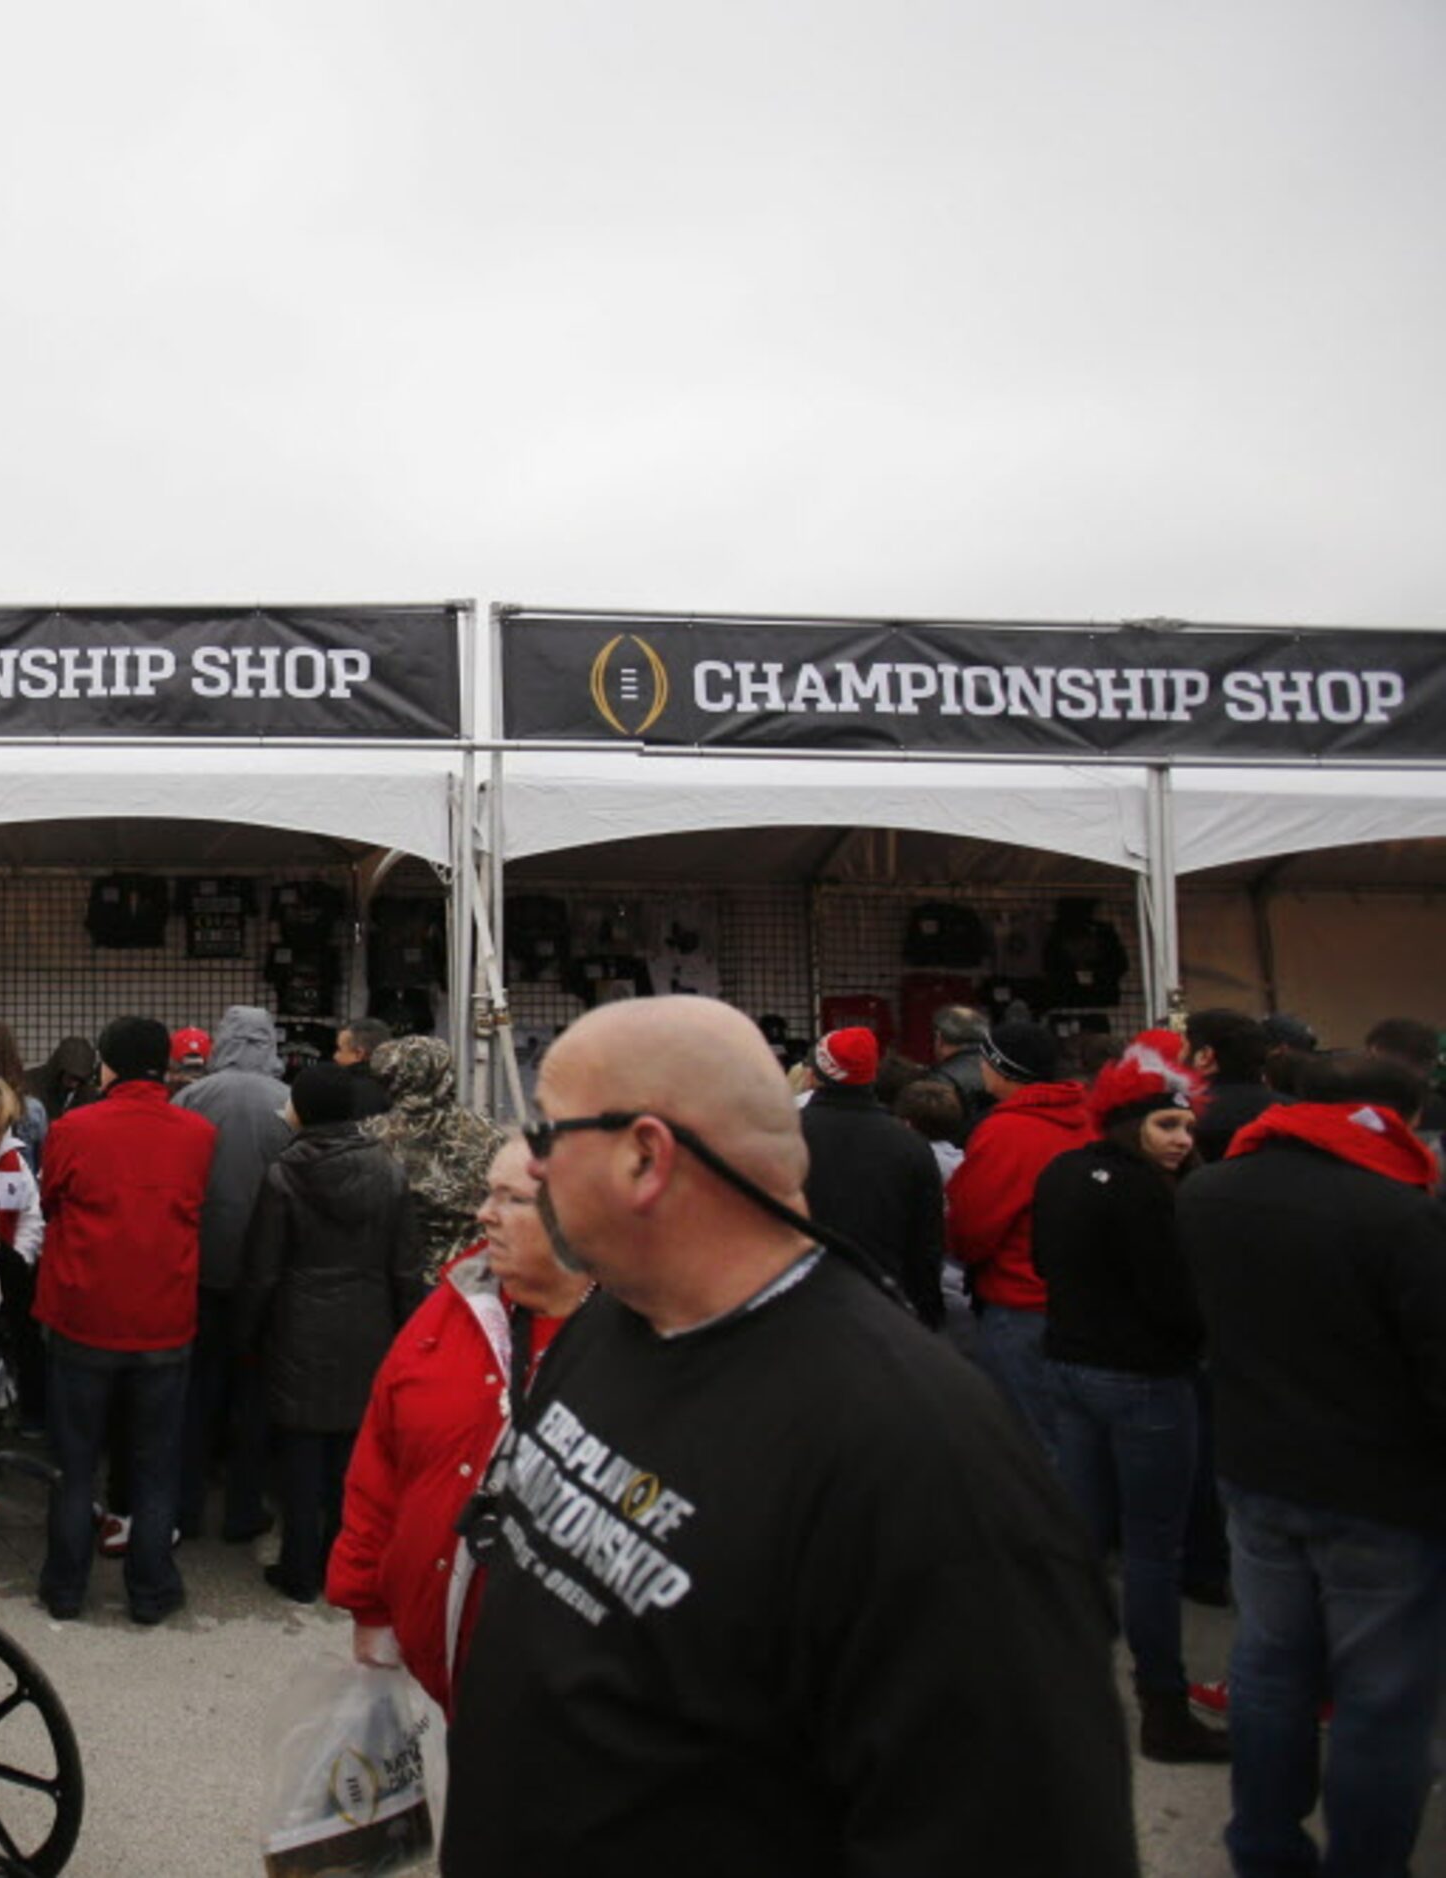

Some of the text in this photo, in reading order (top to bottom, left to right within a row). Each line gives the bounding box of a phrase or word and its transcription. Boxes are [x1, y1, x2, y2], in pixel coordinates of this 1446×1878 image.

[192, 646, 371, 698] SHOP
[694, 661, 1404, 723] CHAMPIONSHIP SHOP
